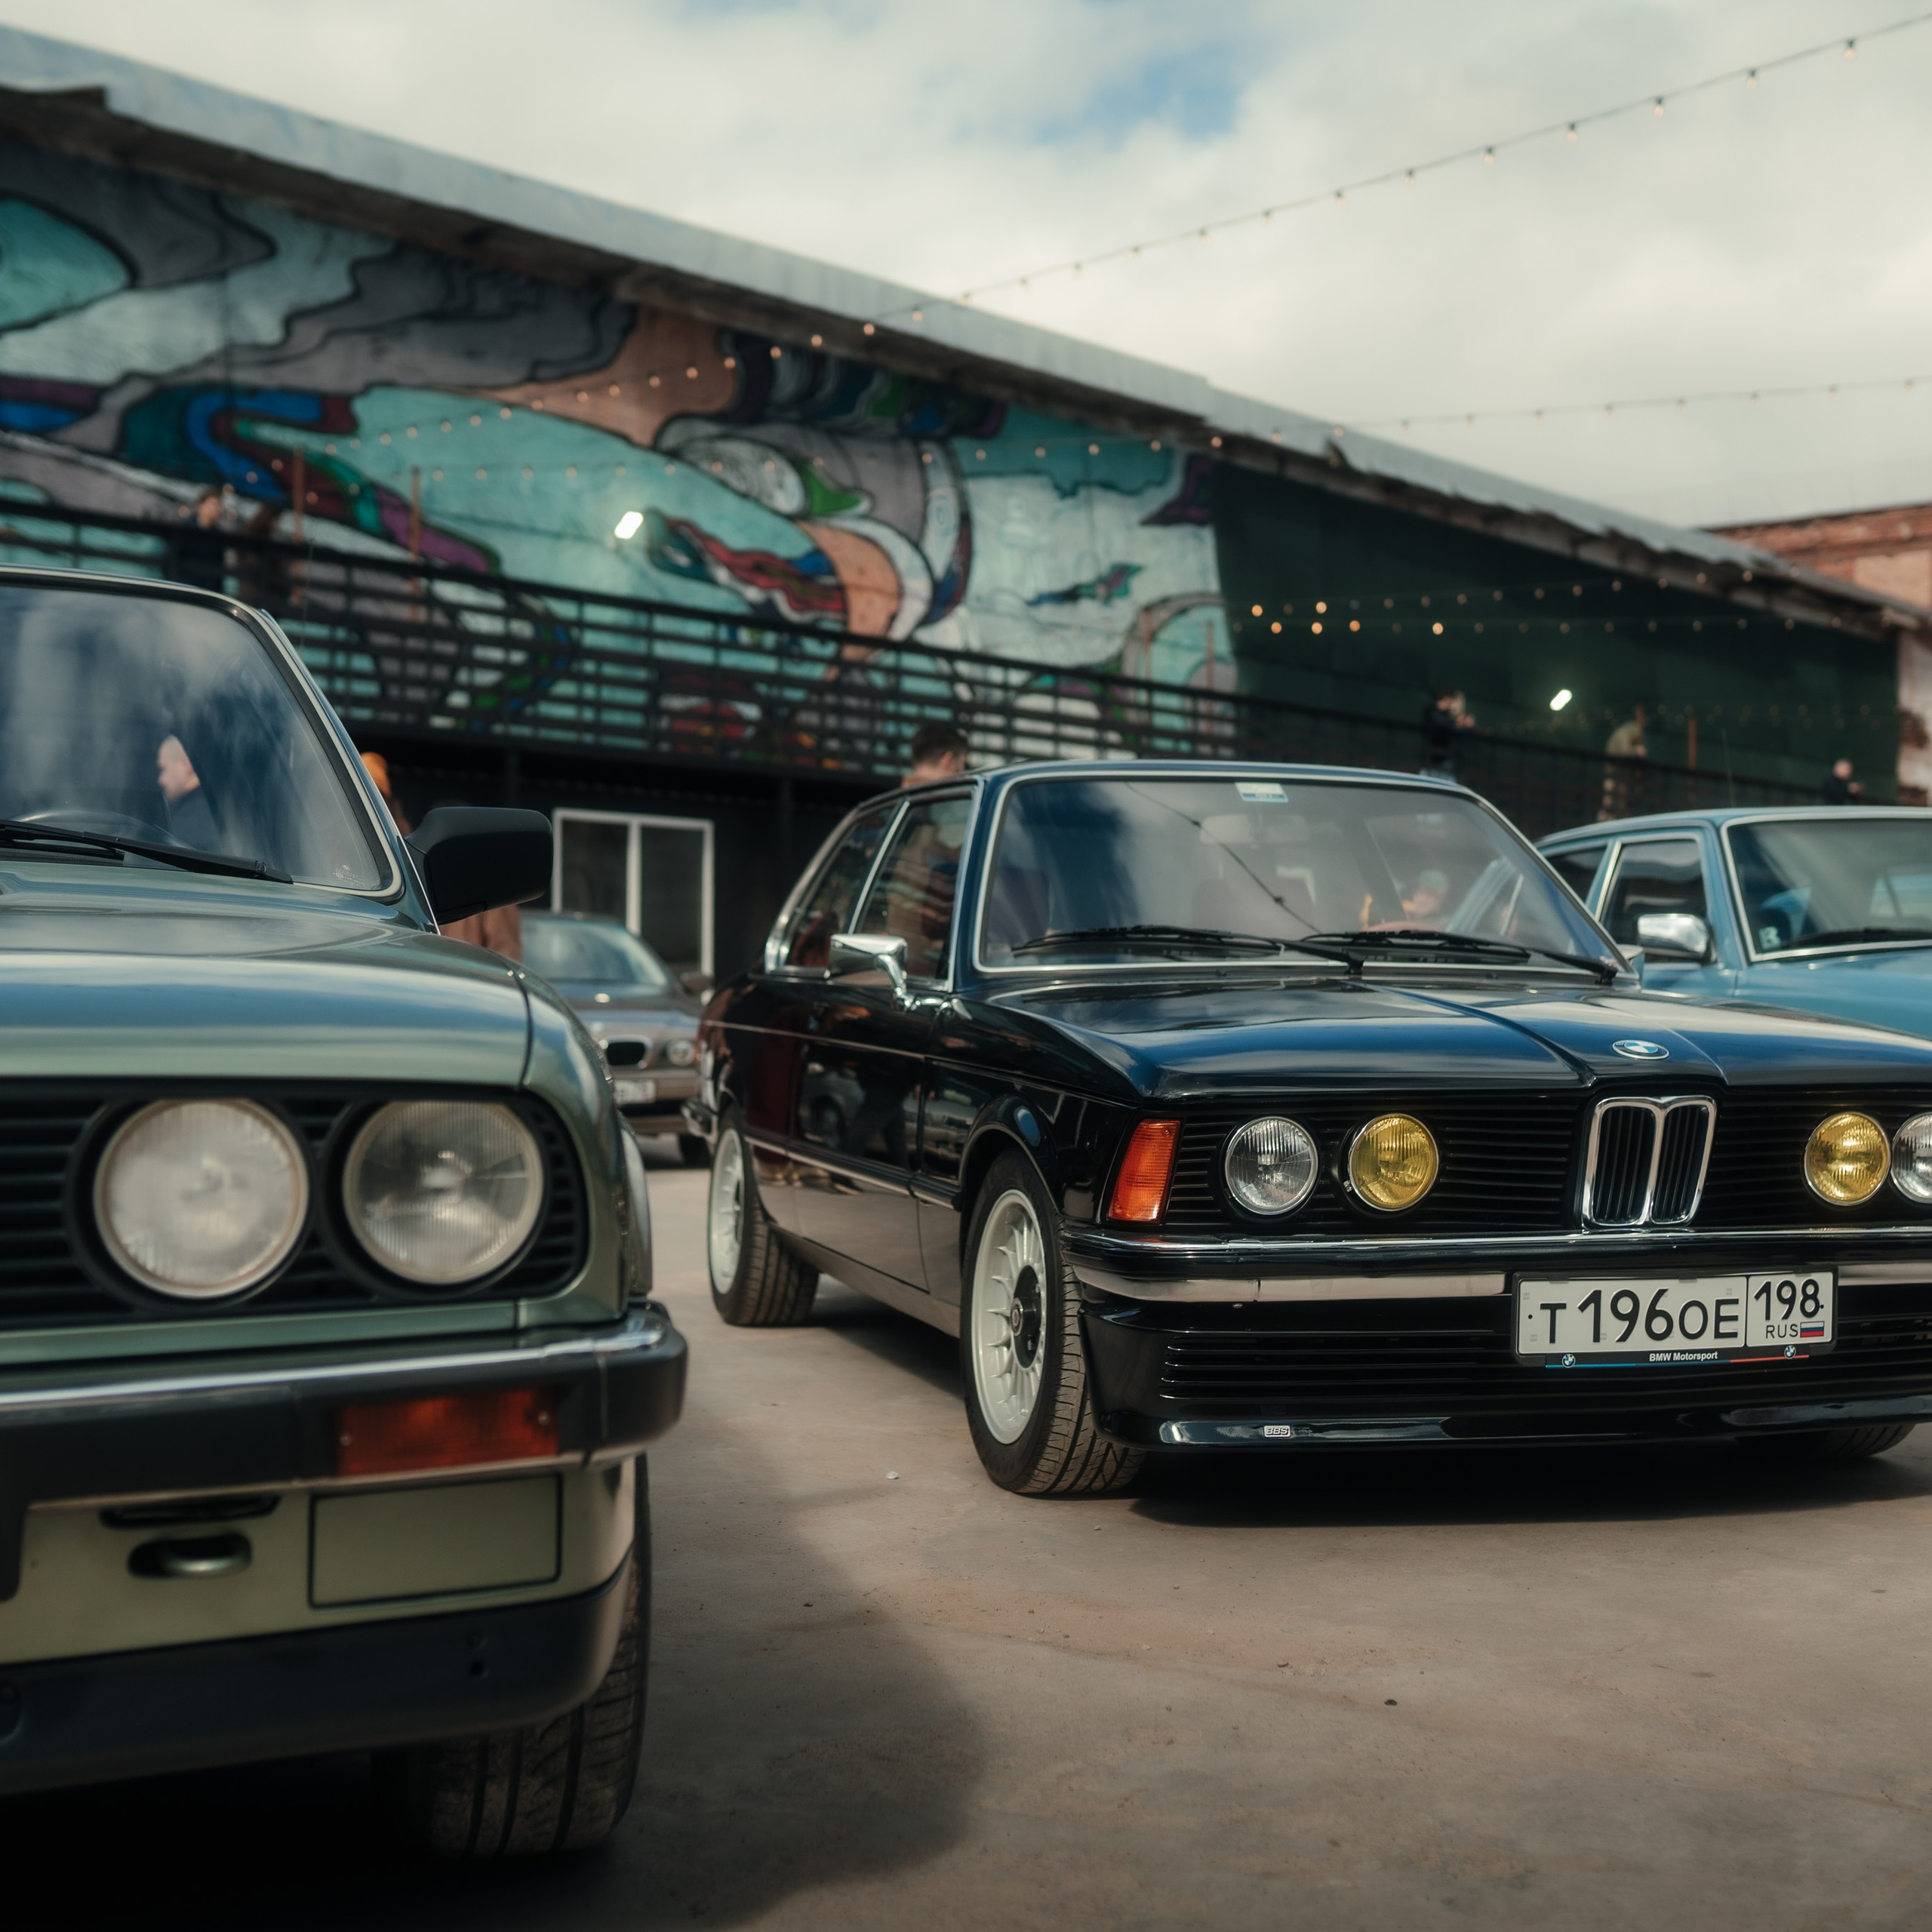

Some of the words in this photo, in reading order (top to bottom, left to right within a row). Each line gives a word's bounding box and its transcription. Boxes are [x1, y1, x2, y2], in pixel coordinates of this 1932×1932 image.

[1753, 1278, 1820, 1321] 198
[1765, 1323, 1798, 1340] RUS
[1649, 1352, 1672, 1361] BMW
[1672, 1351, 1718, 1361] Motorsport
[1266, 1426, 1289, 1435] BBS
